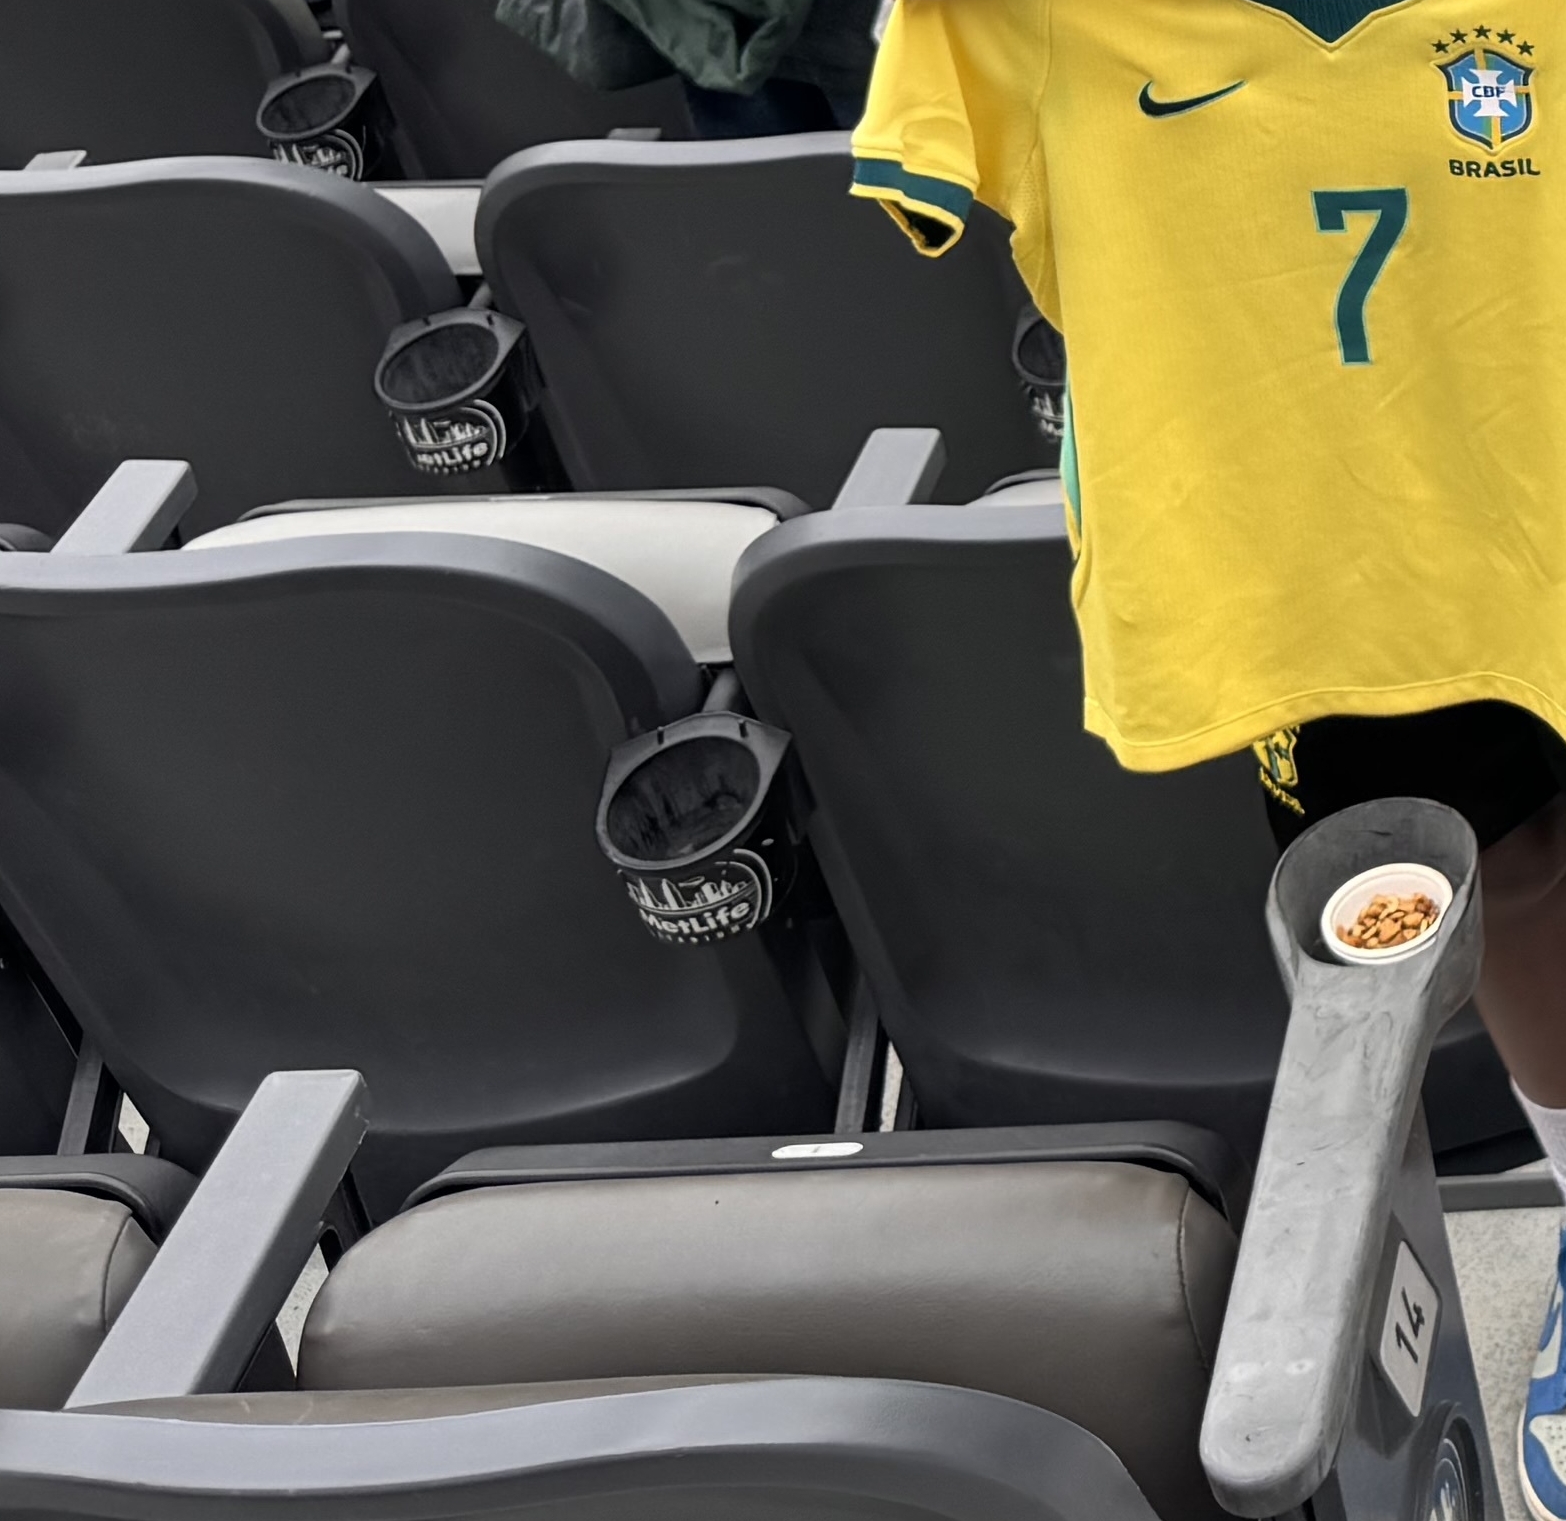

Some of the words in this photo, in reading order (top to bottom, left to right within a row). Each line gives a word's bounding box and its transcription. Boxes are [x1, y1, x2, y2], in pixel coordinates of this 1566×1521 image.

[1471, 84, 1506, 99] CBF
[1449, 157, 1540, 179] BRASIL
[1310, 186, 1412, 366] 7
[1395, 1286, 1425, 1365] 14
